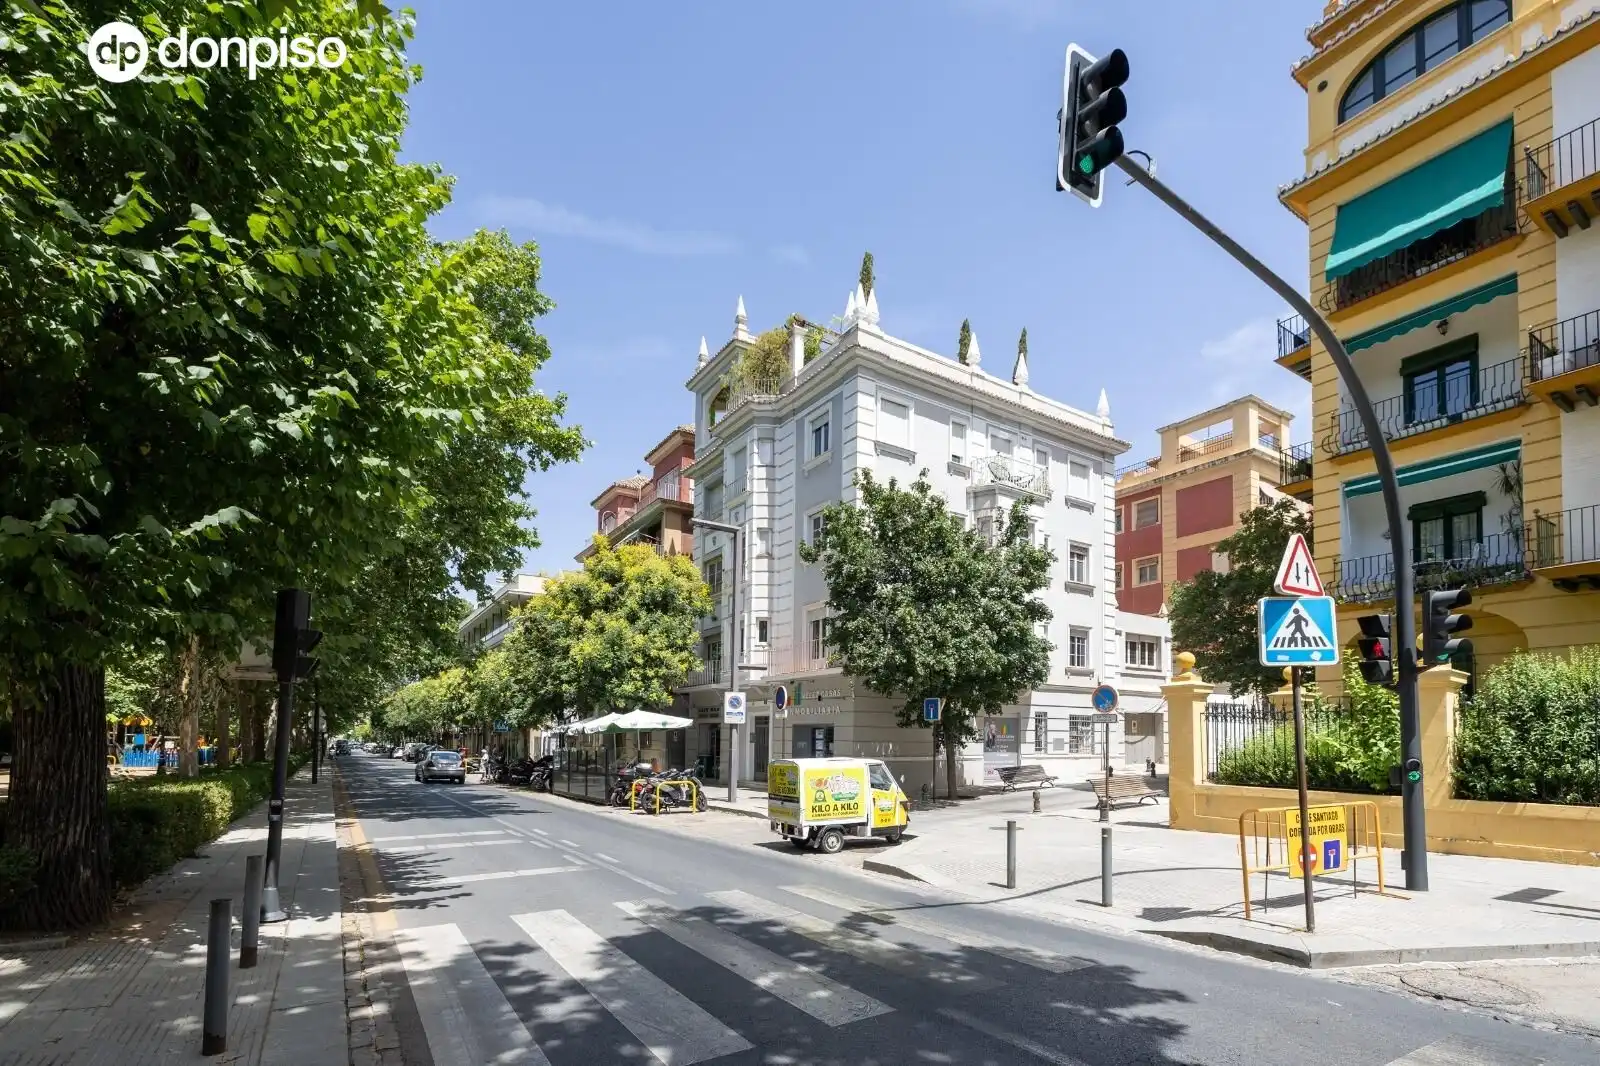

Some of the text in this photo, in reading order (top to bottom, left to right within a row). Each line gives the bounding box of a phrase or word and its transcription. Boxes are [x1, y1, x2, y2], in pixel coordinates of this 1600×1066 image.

[789, 705, 841, 715] NMOBILIARIA
[811, 804, 831, 813] KILO
[840, 802, 859, 811] KILO
[1312, 811, 1338, 822] SANTIAGO
[1289, 823, 1345, 837] CORDA POR OBRAS
